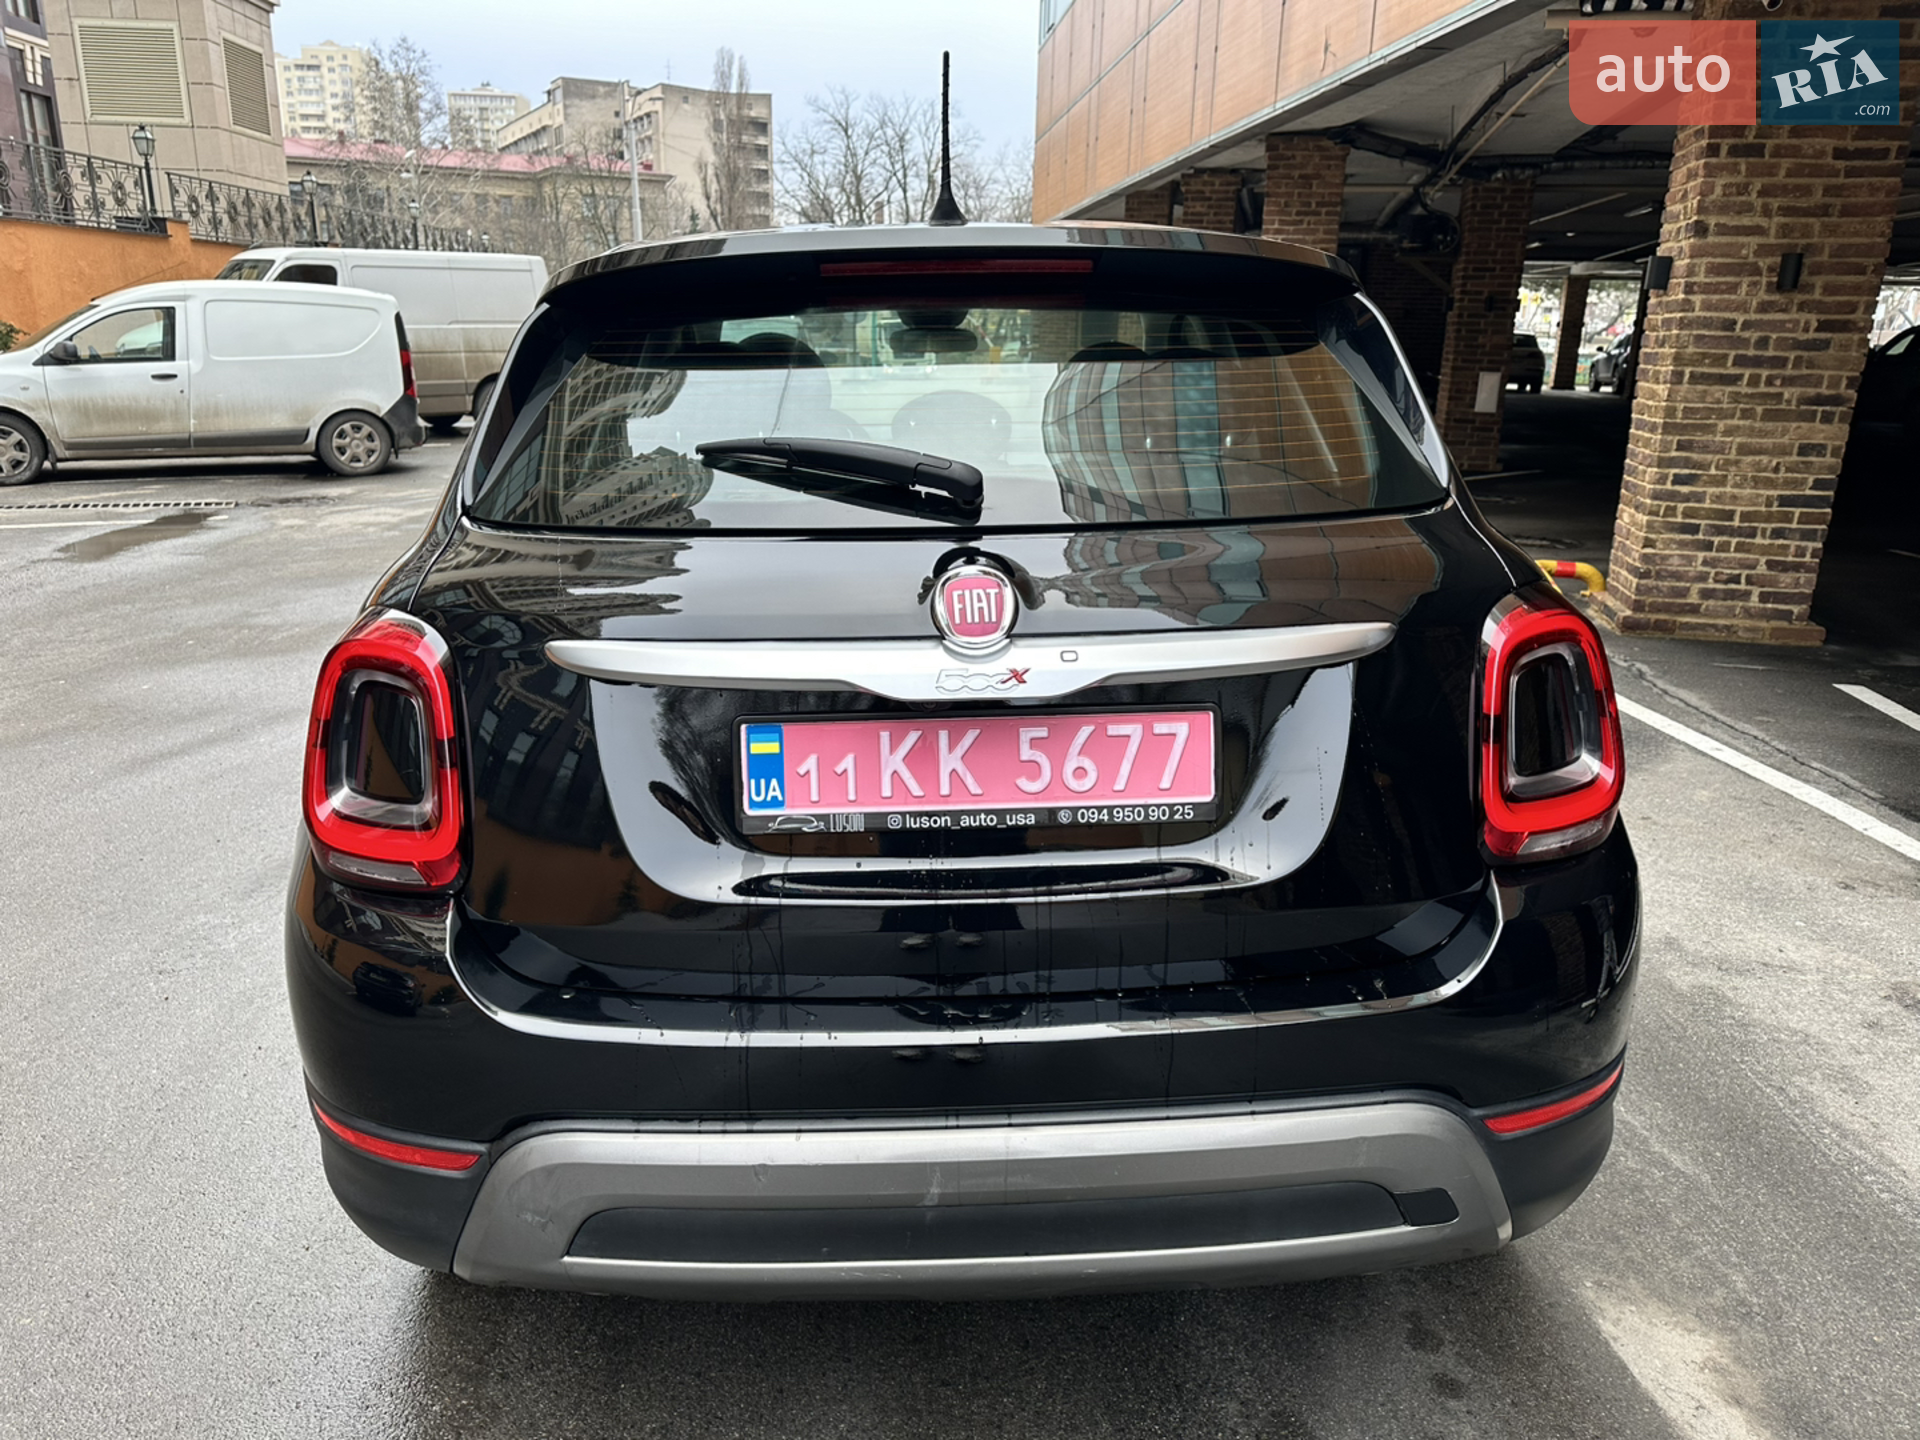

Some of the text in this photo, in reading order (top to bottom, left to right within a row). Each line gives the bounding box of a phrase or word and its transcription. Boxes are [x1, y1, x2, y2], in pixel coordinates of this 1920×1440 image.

[952, 588, 999, 625] FIAT
[796, 722, 1190, 803] 11 KK 5677
[750, 778, 783, 802] UA
[906, 812, 1036, 830] luson_auto_usa
[1077, 805, 1194, 824] 094 950 90 25
